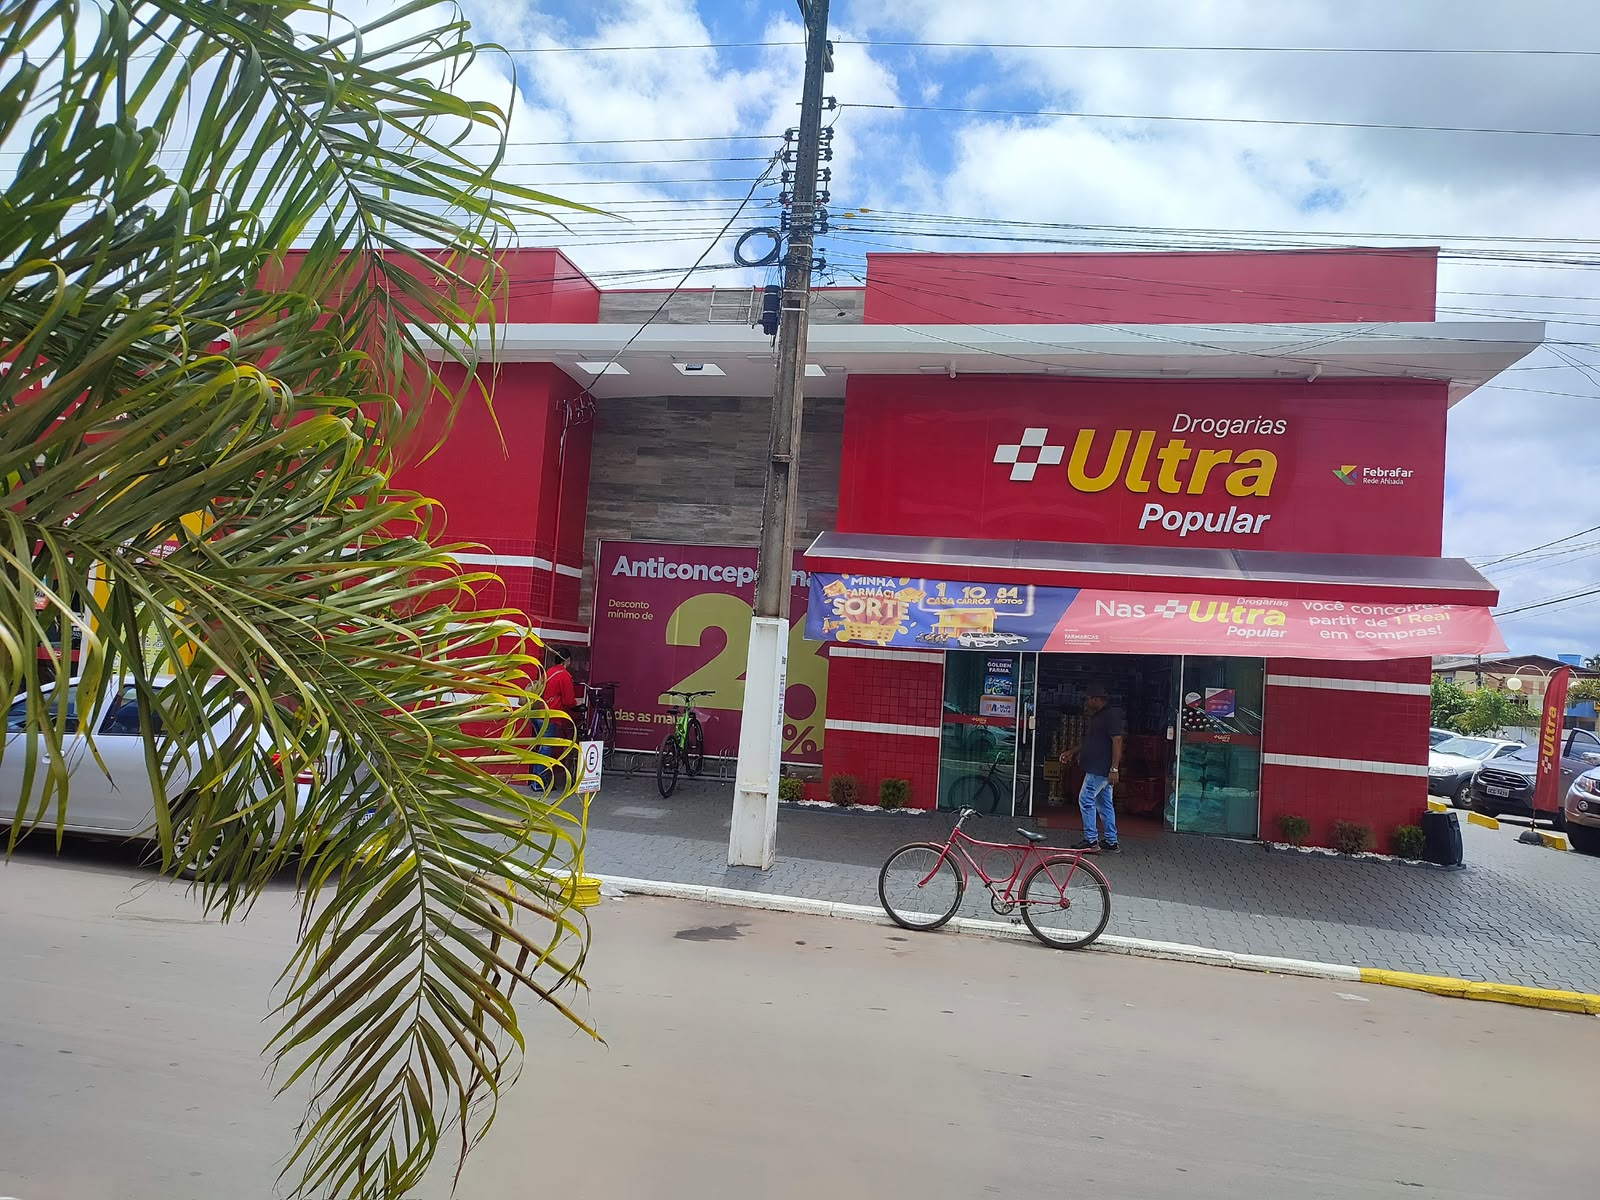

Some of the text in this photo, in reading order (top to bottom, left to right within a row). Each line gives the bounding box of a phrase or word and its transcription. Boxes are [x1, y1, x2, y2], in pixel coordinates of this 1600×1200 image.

[1172, 412, 1287, 438] Drogarias
[1067, 428, 1278, 497] Ultra
[1363, 467, 1414, 478] Febrafar
[1139, 503, 1270, 536] Popular
[850, 576, 896, 588] MINHA
[935, 582, 1018, 599] 1 10 84
[608, 599, 650, 609] Desconto
[832, 597, 910, 620] SORTE
[926, 597, 955, 605] CASA
[1236, 597, 1289, 607] Drogarias
[607, 610, 654, 620] mínimo de
[1095, 600, 1287, 626] Nas Ultra
[1309, 615, 1358, 626] partir
[1364, 618, 1388, 627] de
[1408, 612, 1450, 624] Real
[1226, 626, 1288, 639] Popular
[1320, 625, 1442, 640] em compras!
[637, 713, 651, 723] as
[1542, 706, 1557, 757] Ultra
[589, 751, 595, 766] E
